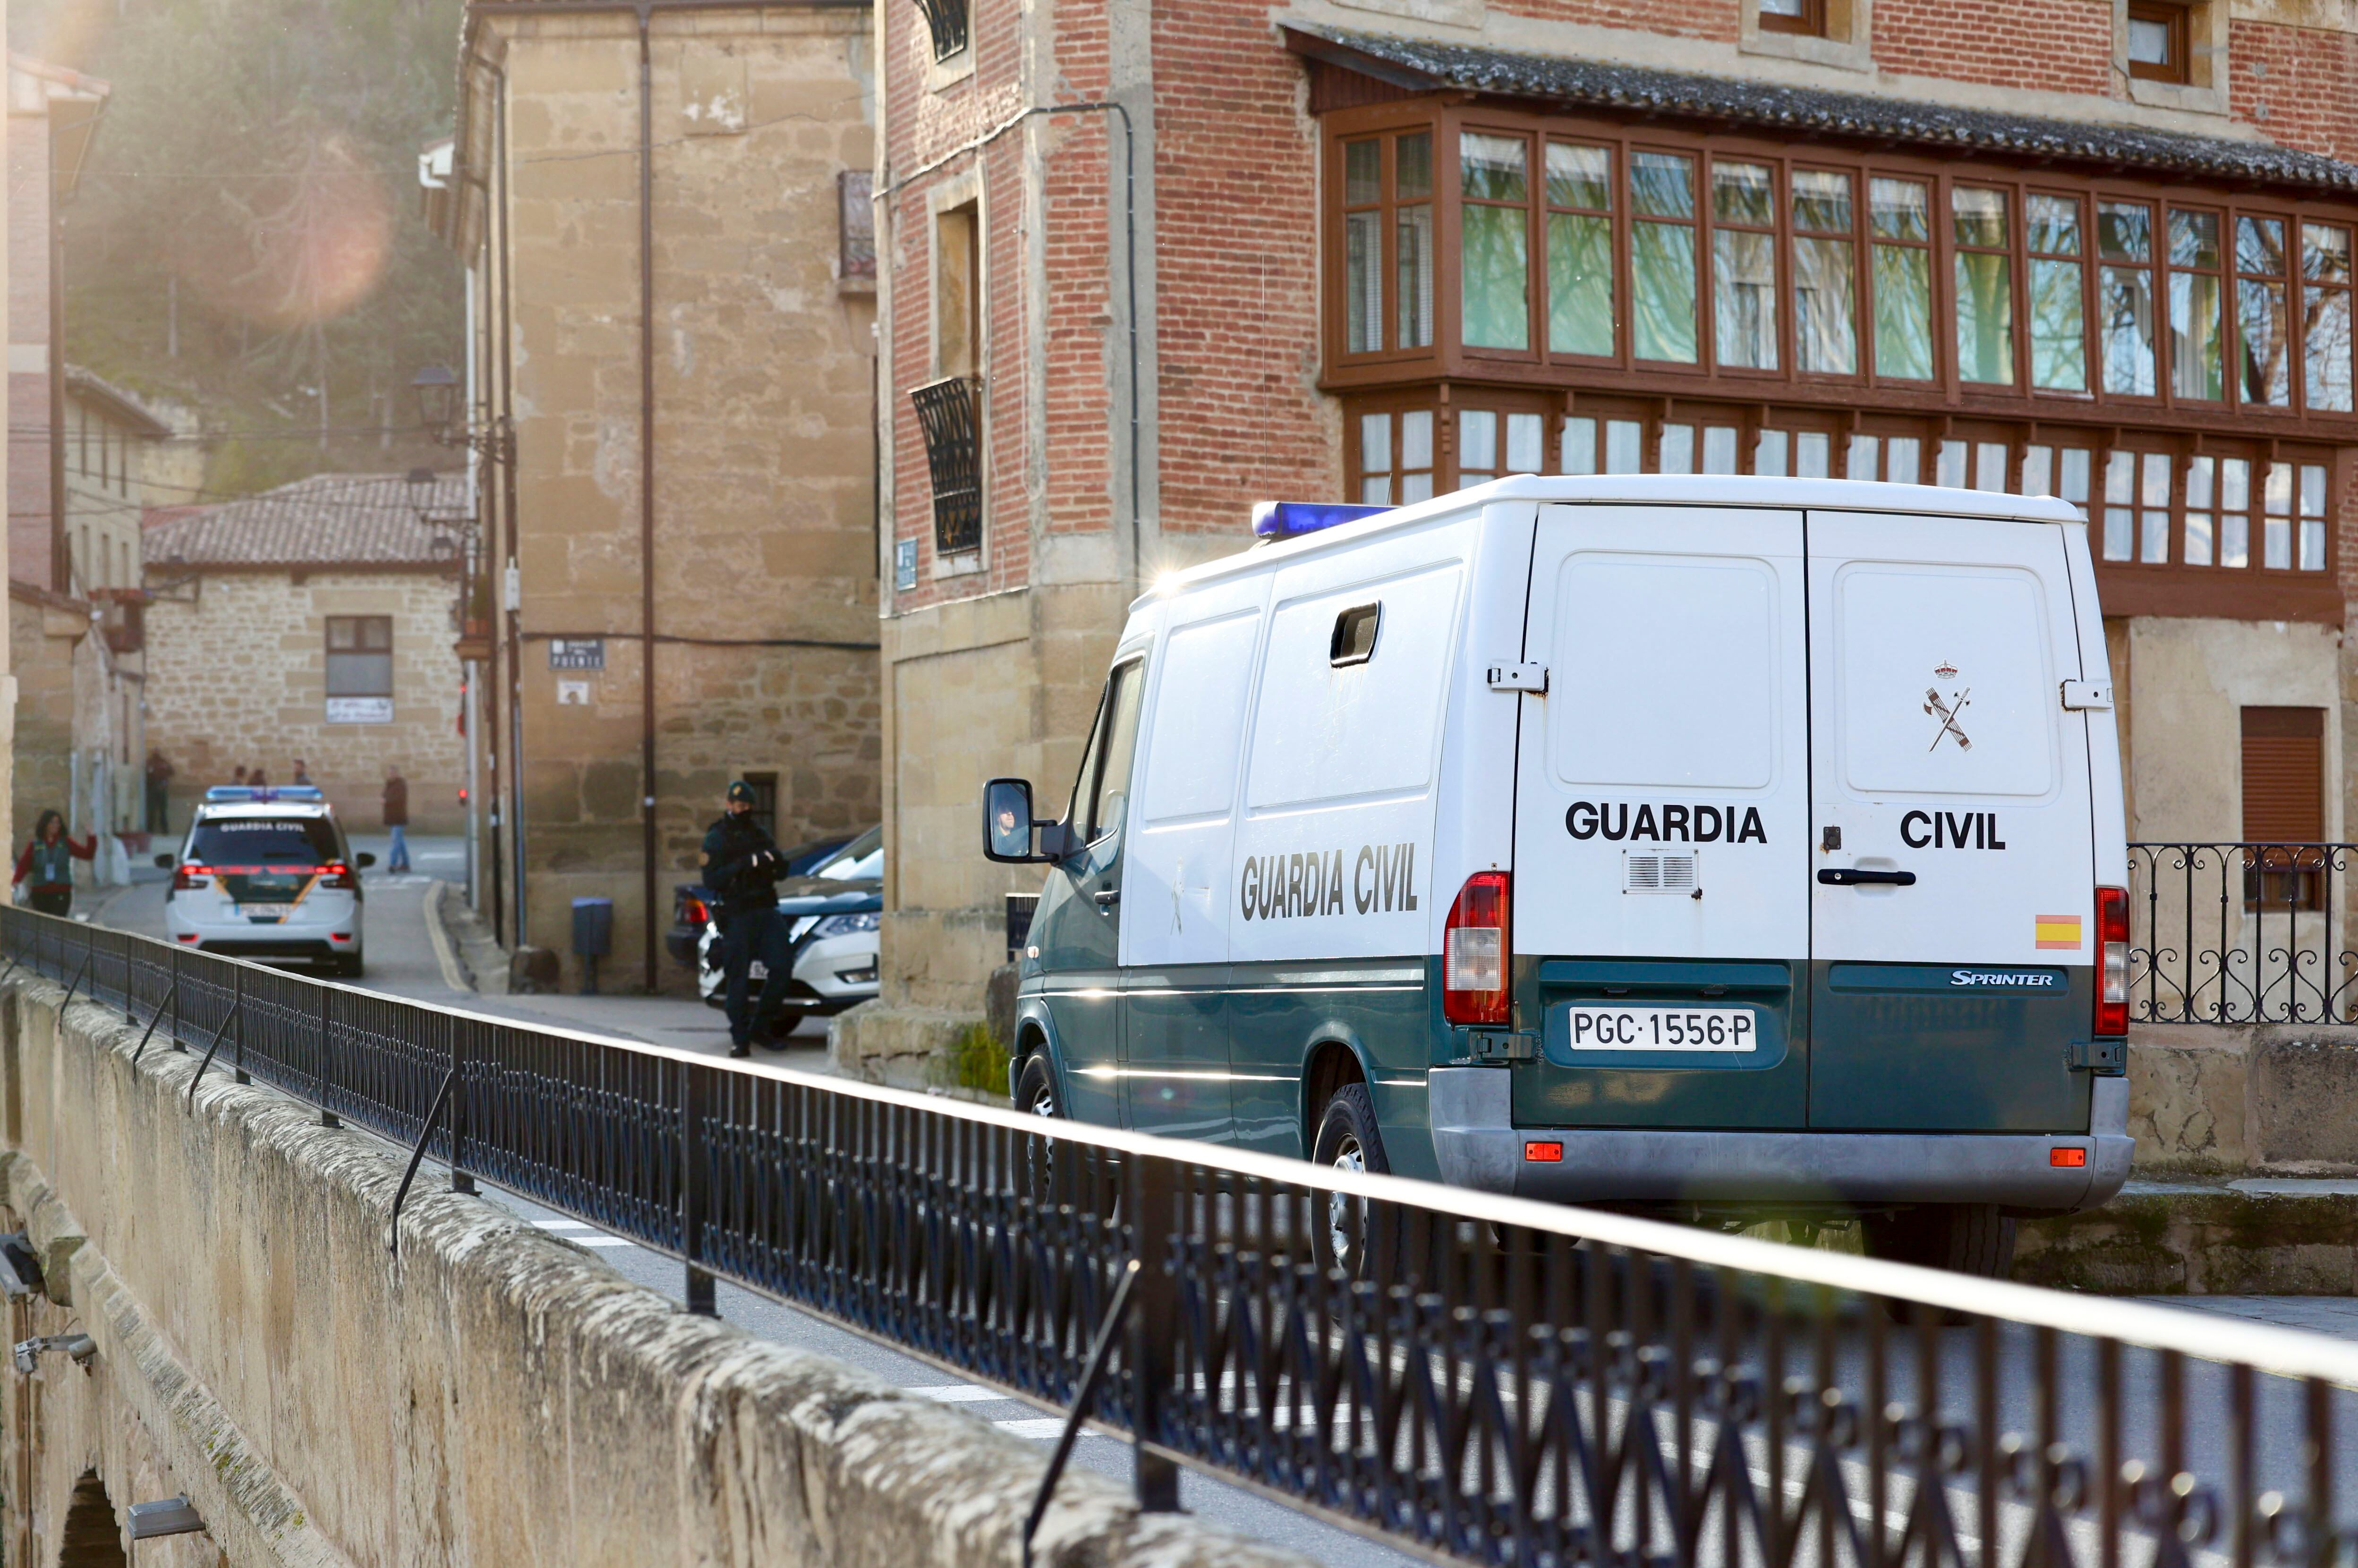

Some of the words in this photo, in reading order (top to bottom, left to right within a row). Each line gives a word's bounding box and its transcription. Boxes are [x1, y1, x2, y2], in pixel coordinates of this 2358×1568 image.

[221, 821, 273, 832] GUARDIA
[277, 821, 305, 832] CIVIL
[1565, 801, 1767, 844] GUARDIA
[1900, 810, 2006, 850] CIVIL
[1241, 849, 1344, 921] GUARDIA
[1354, 843, 1417, 915] CIVIL
